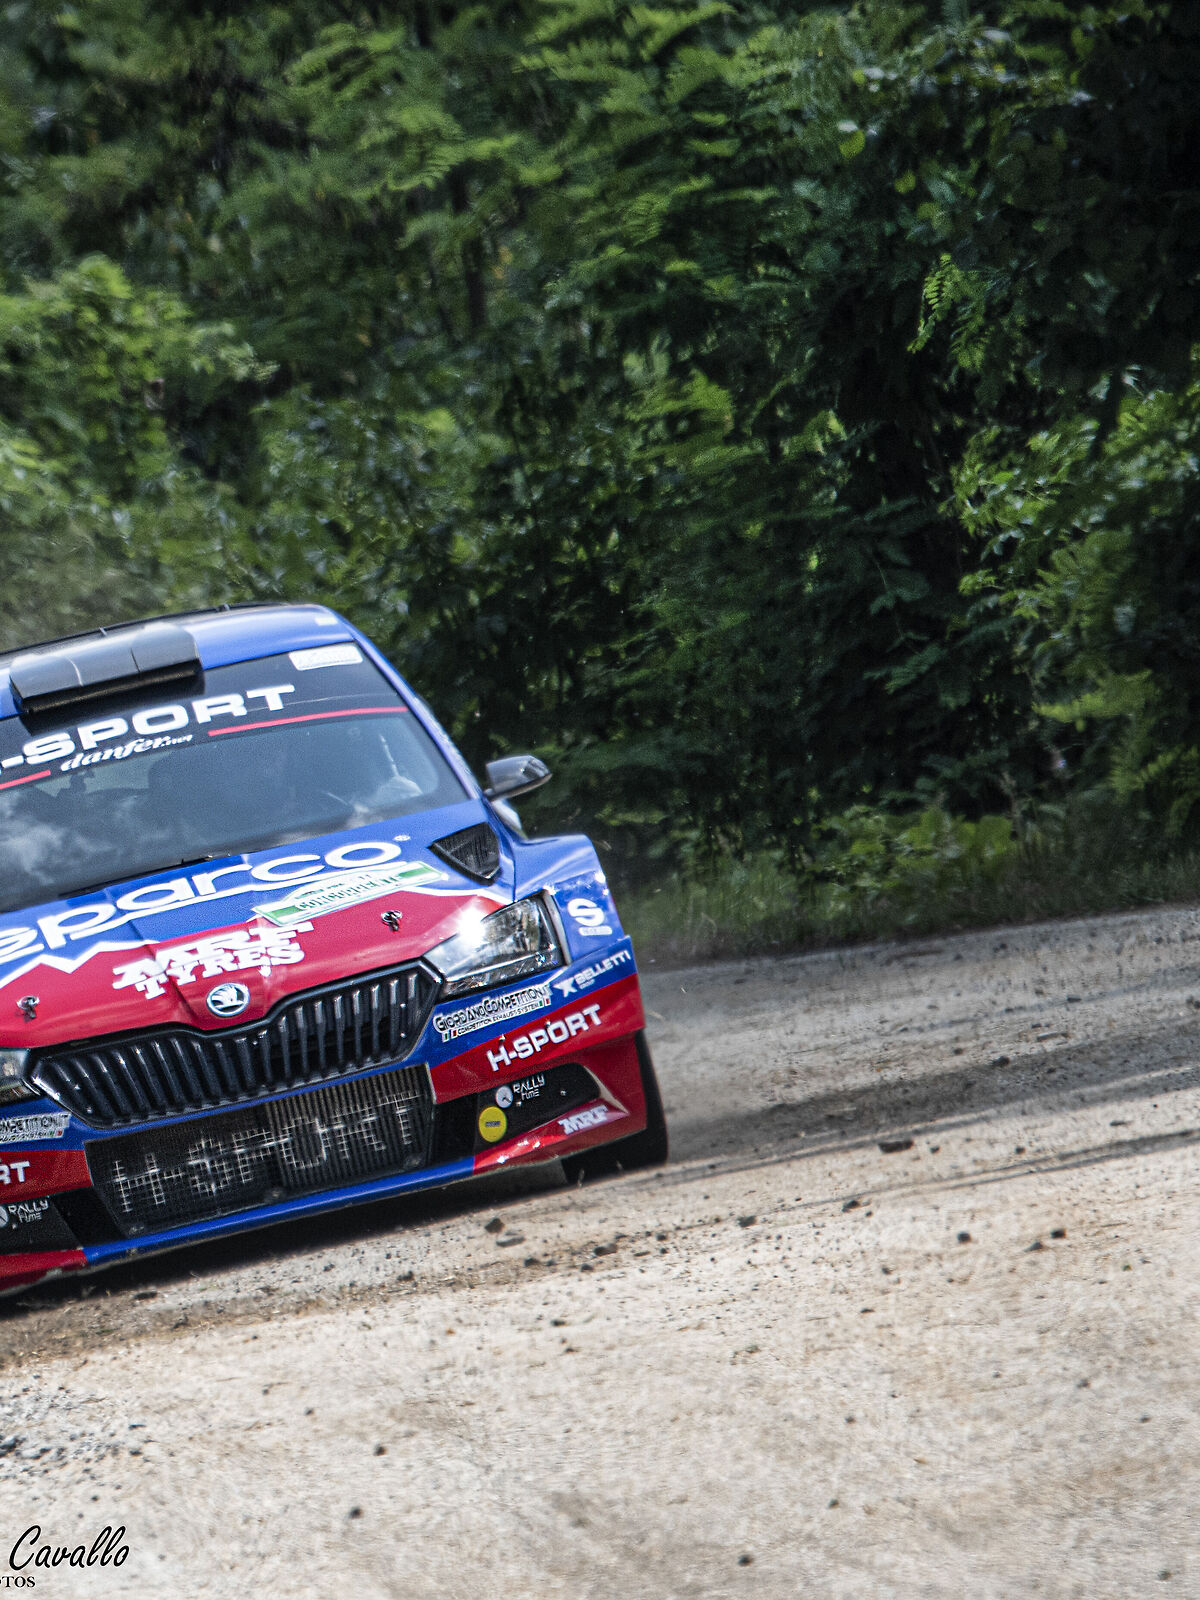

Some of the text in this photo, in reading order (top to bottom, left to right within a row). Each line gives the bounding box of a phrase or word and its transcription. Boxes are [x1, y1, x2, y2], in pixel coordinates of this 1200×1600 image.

[112, 921, 314, 990] MRF
[134, 942, 306, 1000] TYRES
[486, 1004, 603, 1072] H-SPORT
[512, 1073, 546, 1094] RALLY
[557, 1105, 608, 1135] MRF
[7, 1199, 49, 1215] RALLY
